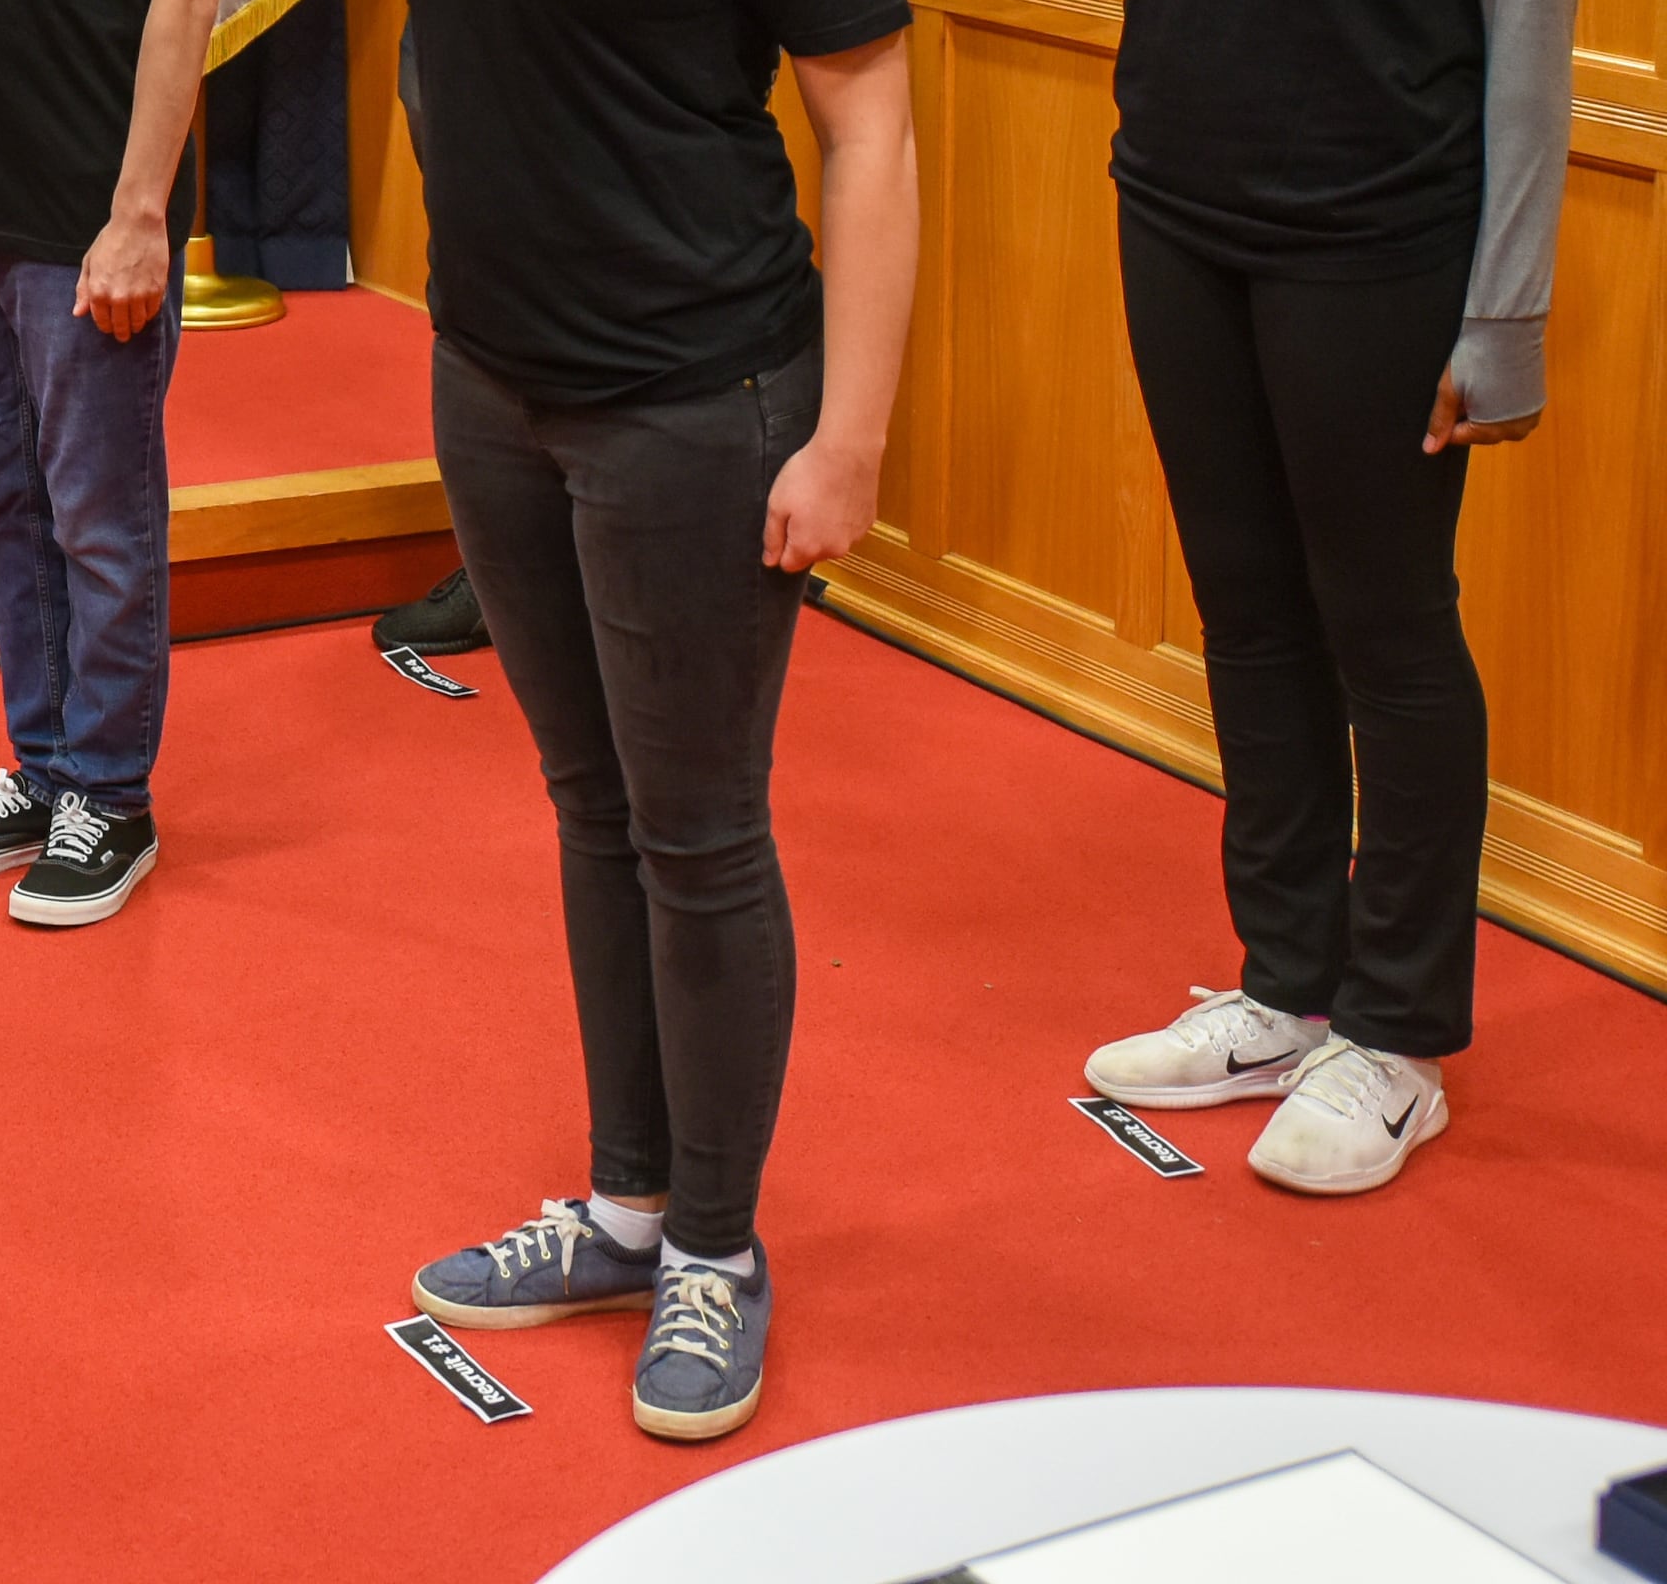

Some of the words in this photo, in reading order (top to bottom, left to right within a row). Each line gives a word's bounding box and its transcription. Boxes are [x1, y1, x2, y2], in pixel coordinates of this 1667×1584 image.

[1103, 1109, 1132, 1122] #3
[1124, 1124, 1180, 1163] Recruit
[421, 1334, 452, 1355] #1
[443, 1354, 505, 1405] Recruit
